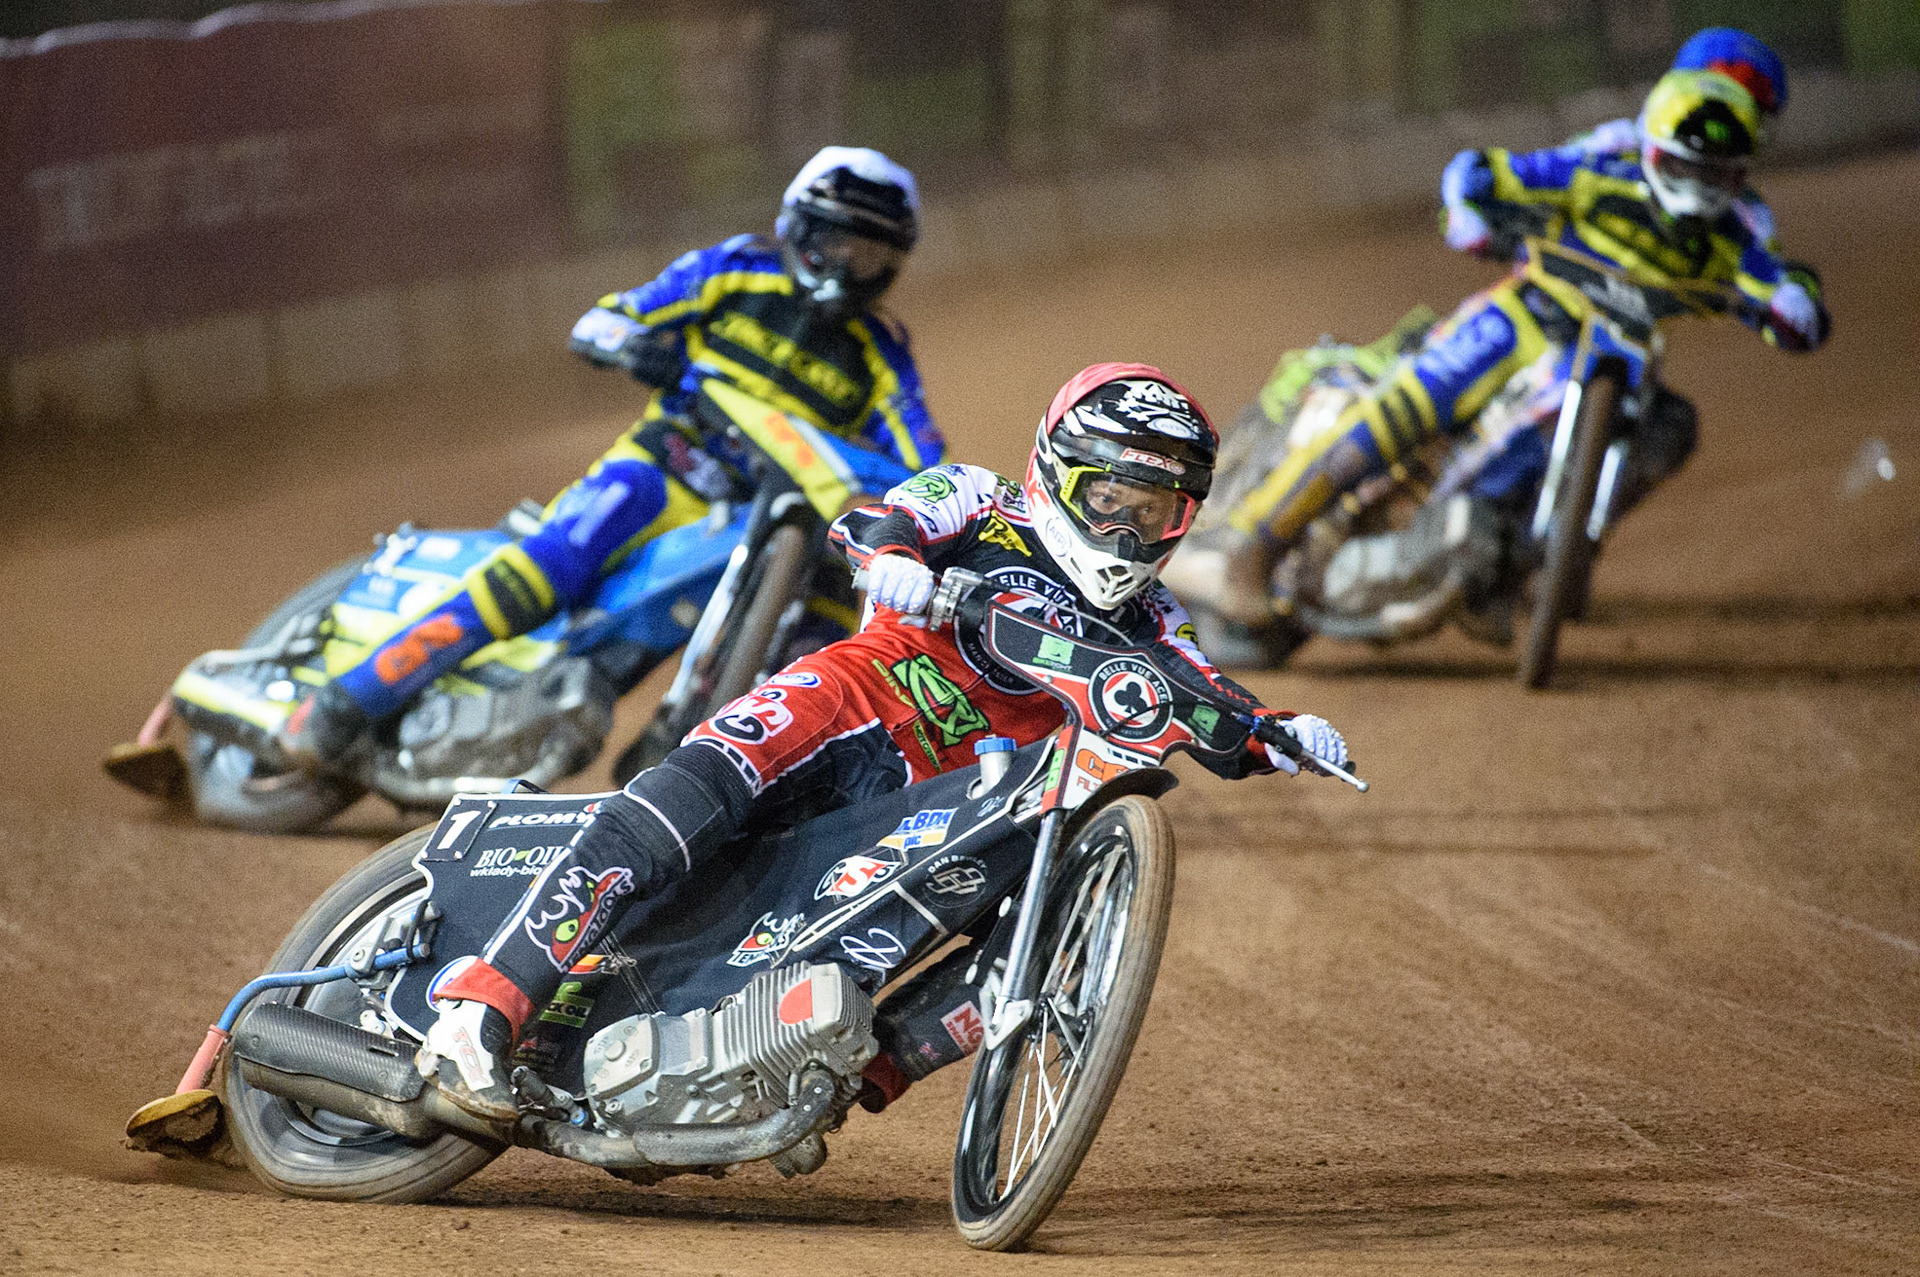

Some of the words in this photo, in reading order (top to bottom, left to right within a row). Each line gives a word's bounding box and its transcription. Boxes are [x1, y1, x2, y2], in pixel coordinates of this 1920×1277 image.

[999, 574, 1037, 591] ELLE
[1098, 662, 1128, 681] BELLE
[1131, 663, 1153, 680] VUE
[1152, 680, 1168, 704] ACE
[437, 810, 482, 851] 1
[474, 846, 517, 868] BIO
[927, 856, 950, 874] DAN
